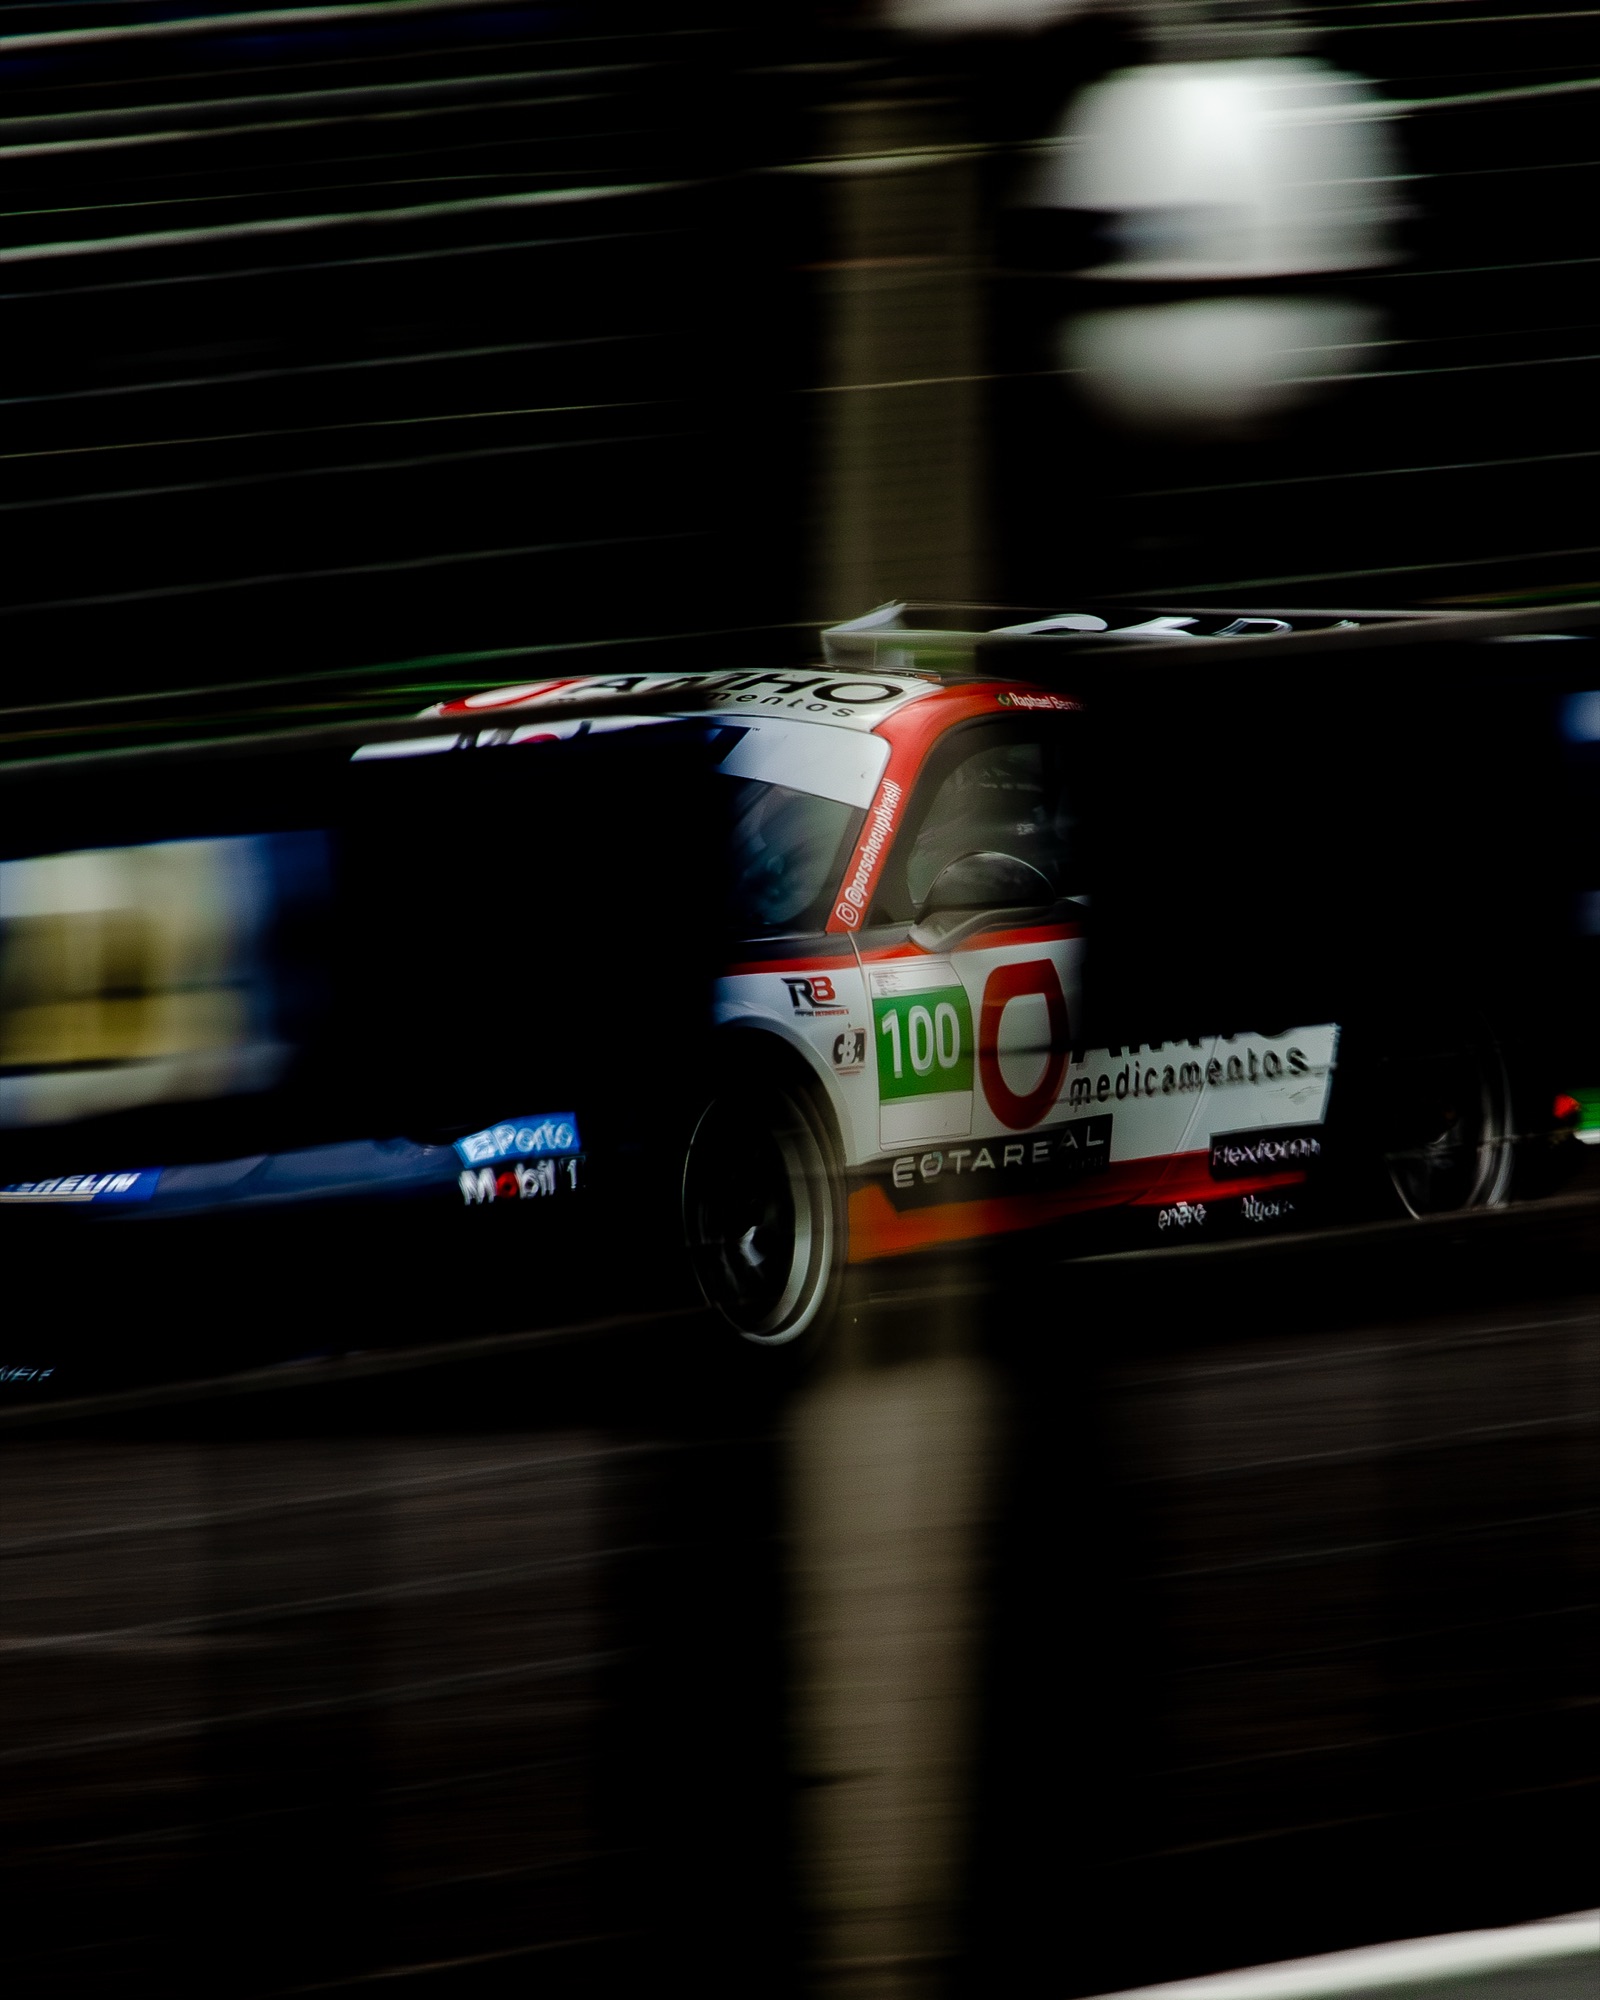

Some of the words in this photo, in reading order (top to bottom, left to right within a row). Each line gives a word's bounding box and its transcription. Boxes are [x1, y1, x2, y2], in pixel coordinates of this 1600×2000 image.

[781, 976, 846, 1008] RB
[882, 1002, 960, 1078] 100
[1068, 1047, 1310, 1112] medicamentos
[459, 1159, 556, 1206] Mobil
[566, 1158, 578, 1190] 1
